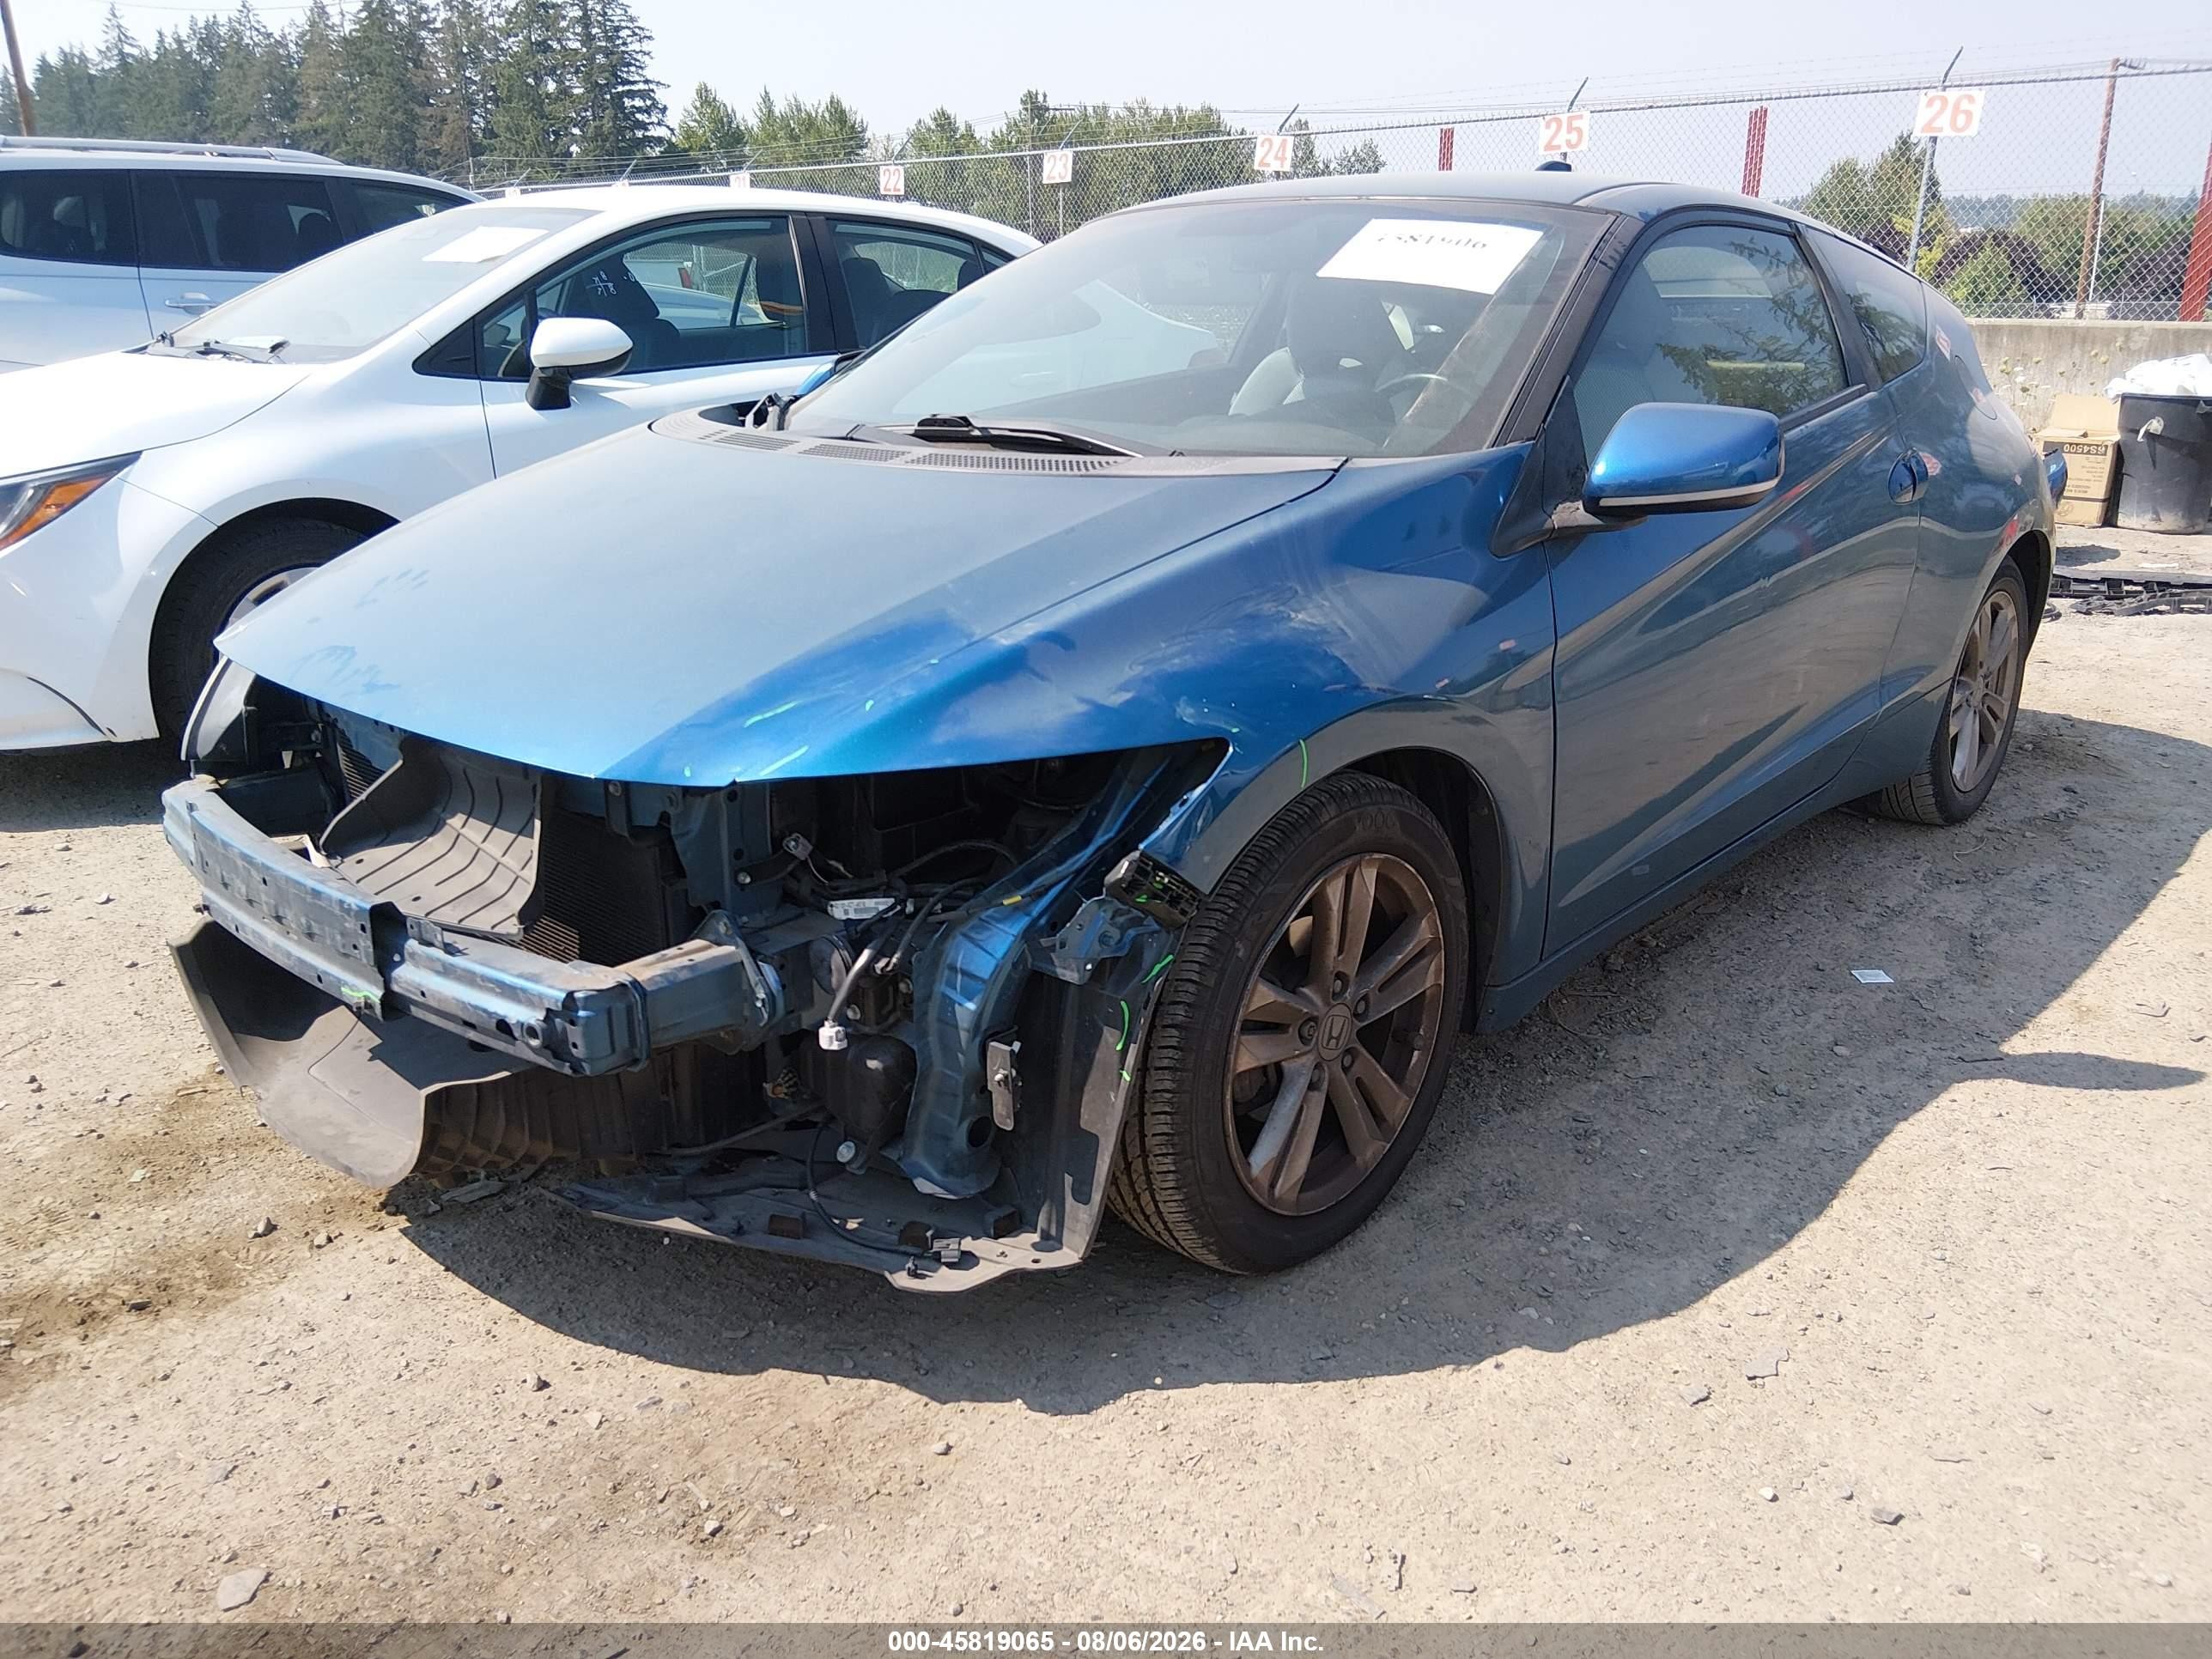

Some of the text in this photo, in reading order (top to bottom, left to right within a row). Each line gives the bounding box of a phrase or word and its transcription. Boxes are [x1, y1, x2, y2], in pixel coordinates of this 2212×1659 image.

[1921, 94, 1975, 134] 26
[1543, 114, 1583, 151] 25
[1046, 154, 1069, 180] 23
[1258, 137, 1288, 168] 24
[883, 167, 902, 192] 22
